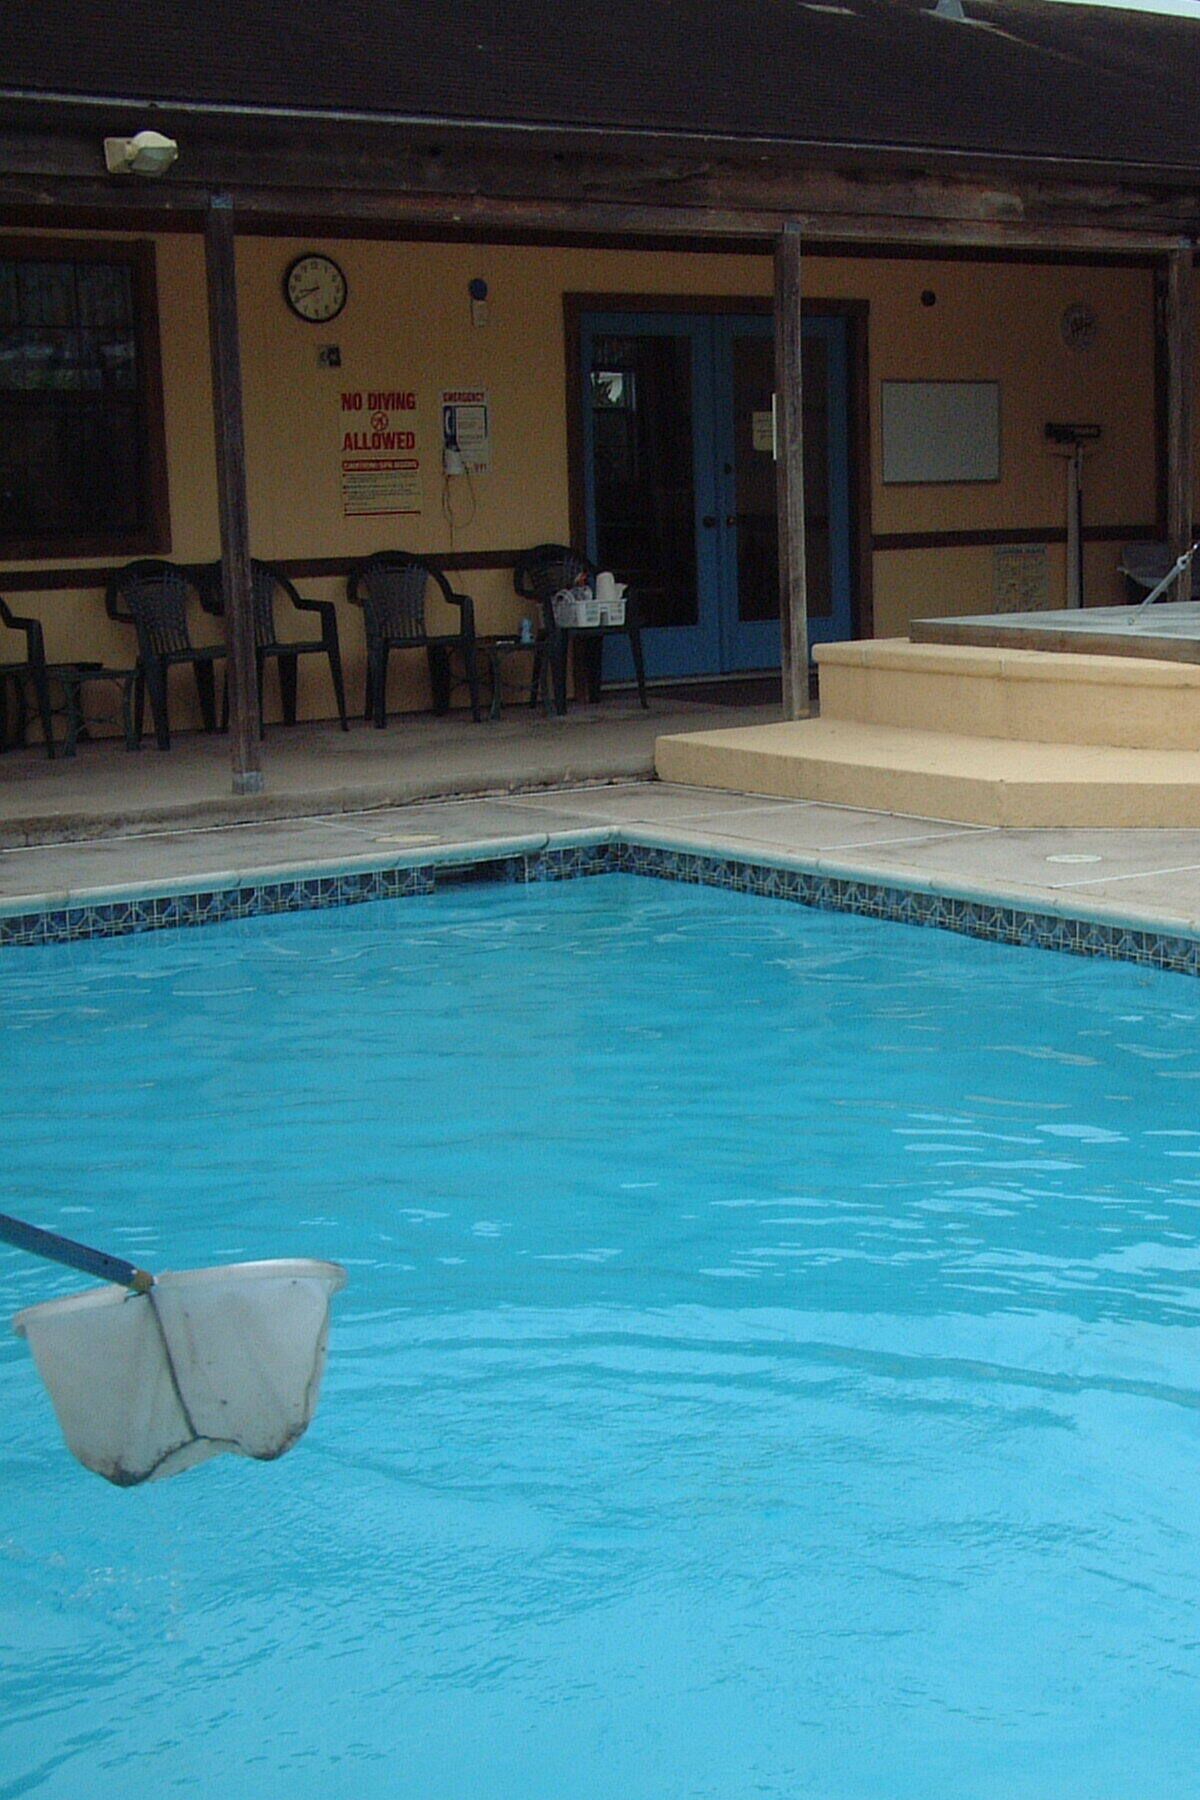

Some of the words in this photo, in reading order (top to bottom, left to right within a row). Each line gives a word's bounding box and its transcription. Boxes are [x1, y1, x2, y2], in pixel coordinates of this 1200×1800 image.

[341, 392, 362, 411] NO
[368, 391, 416, 410] DIVING
[443, 391, 484, 402] EMERGENCY
[343, 431, 416, 450] ALLOWED
